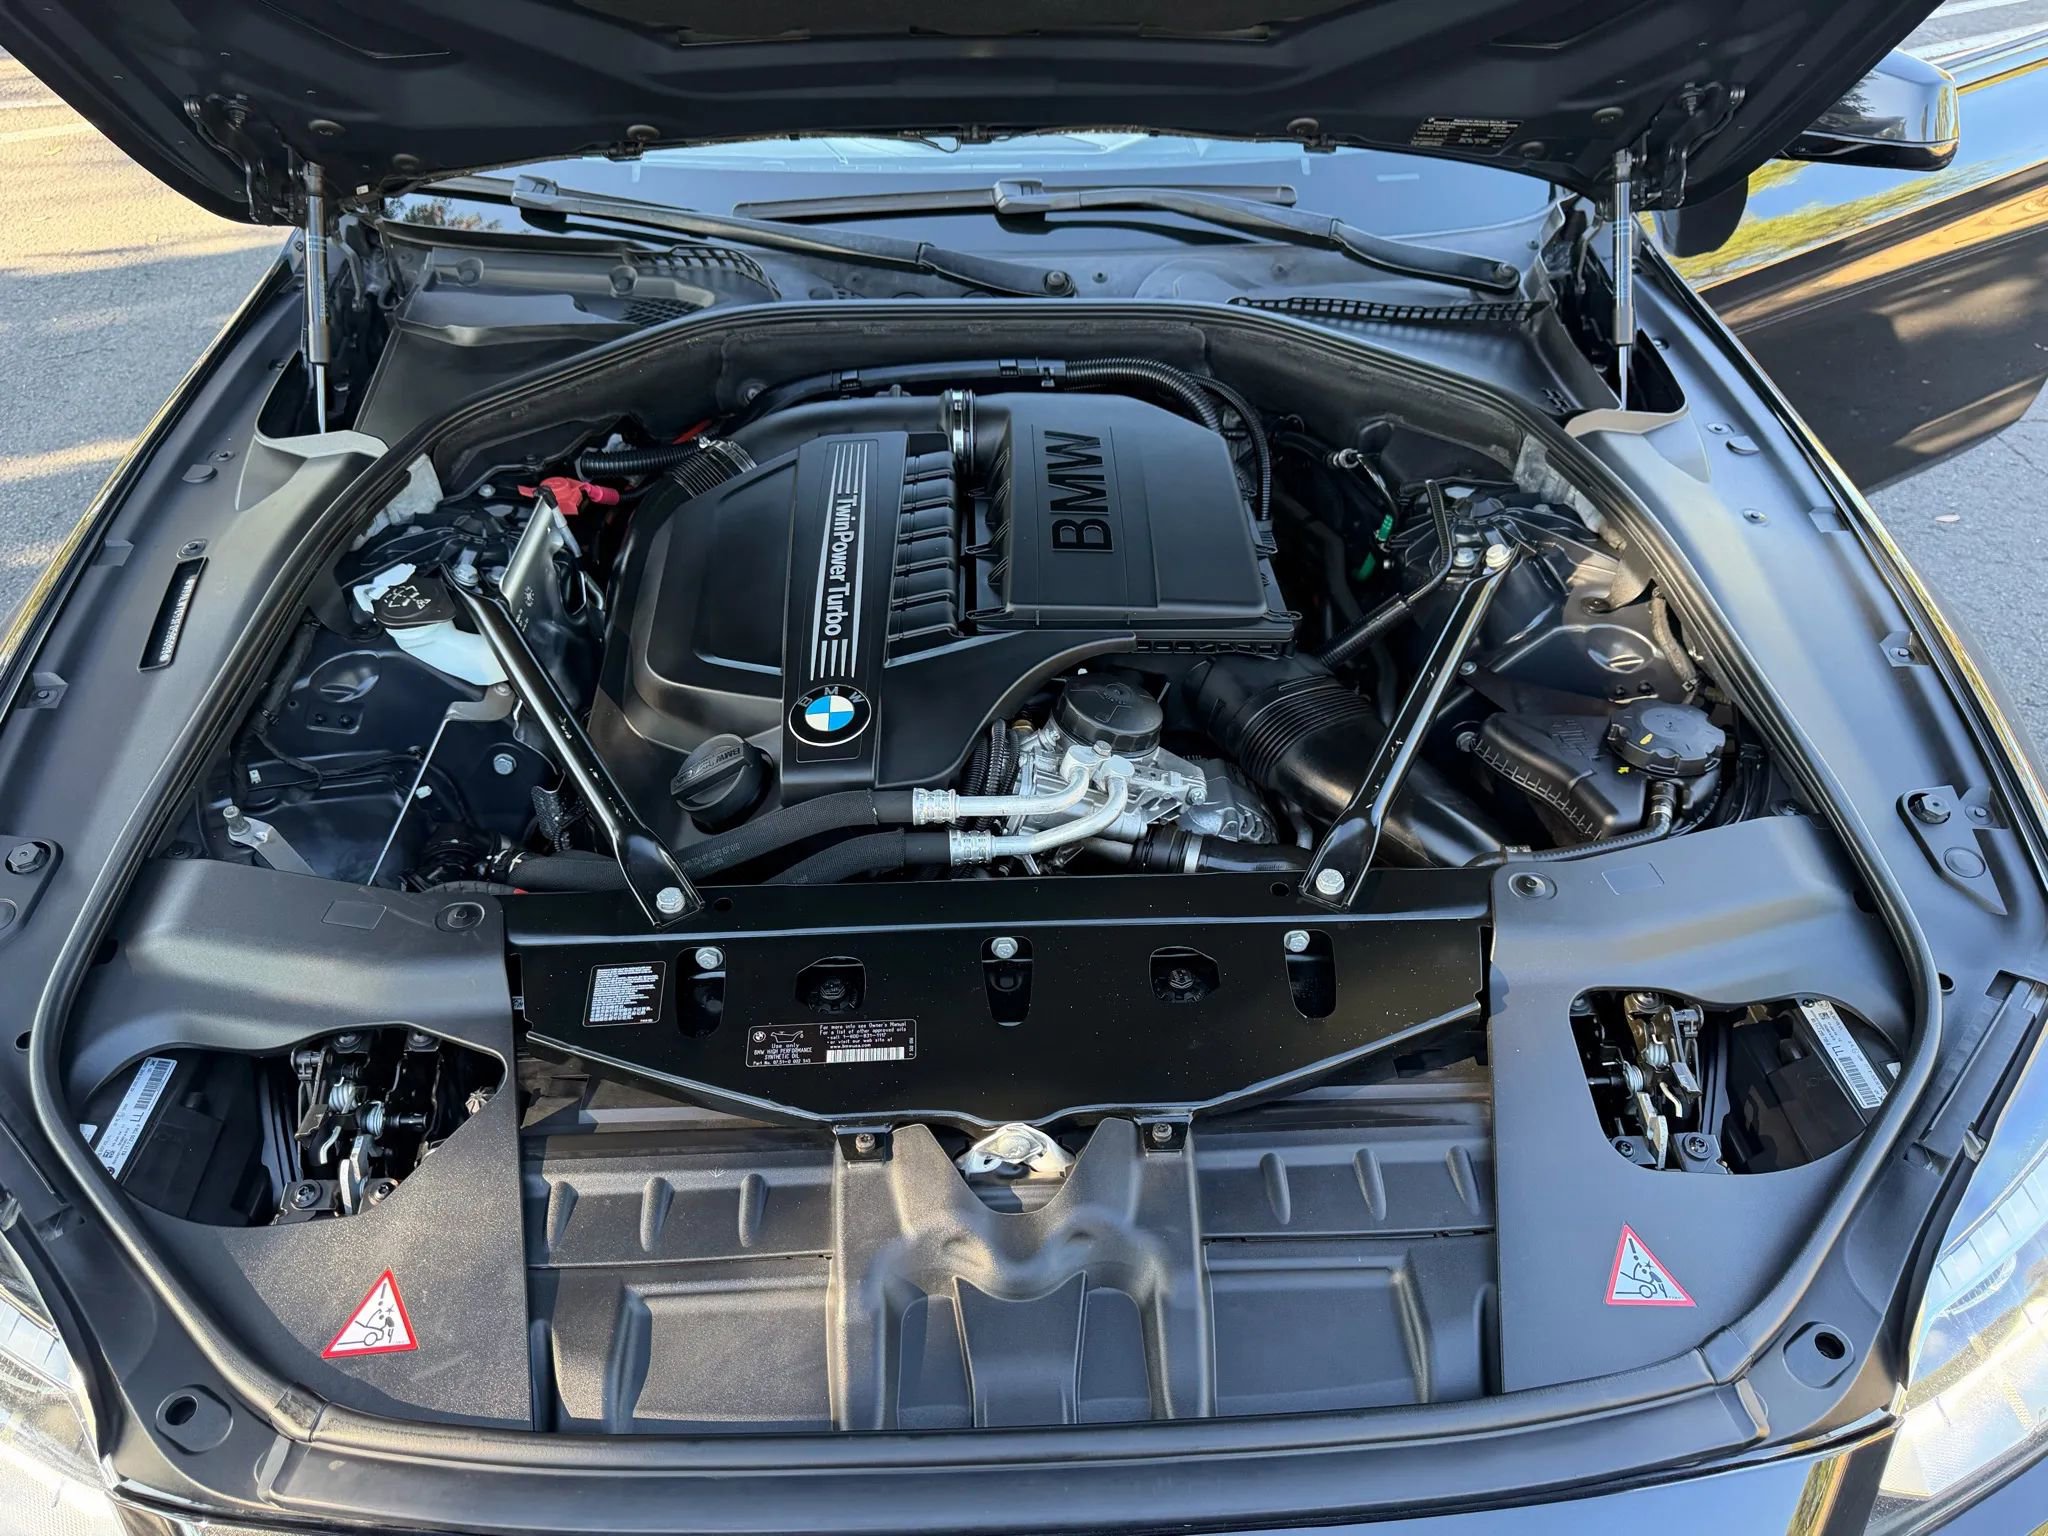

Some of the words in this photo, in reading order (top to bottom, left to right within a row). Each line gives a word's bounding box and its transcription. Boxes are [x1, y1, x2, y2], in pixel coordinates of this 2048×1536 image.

[1044, 430, 1114, 553] BMW
[830, 494, 858, 582] TwinPower
[824, 582, 850, 636] Turbo
[798, 686, 865, 708] BMW
